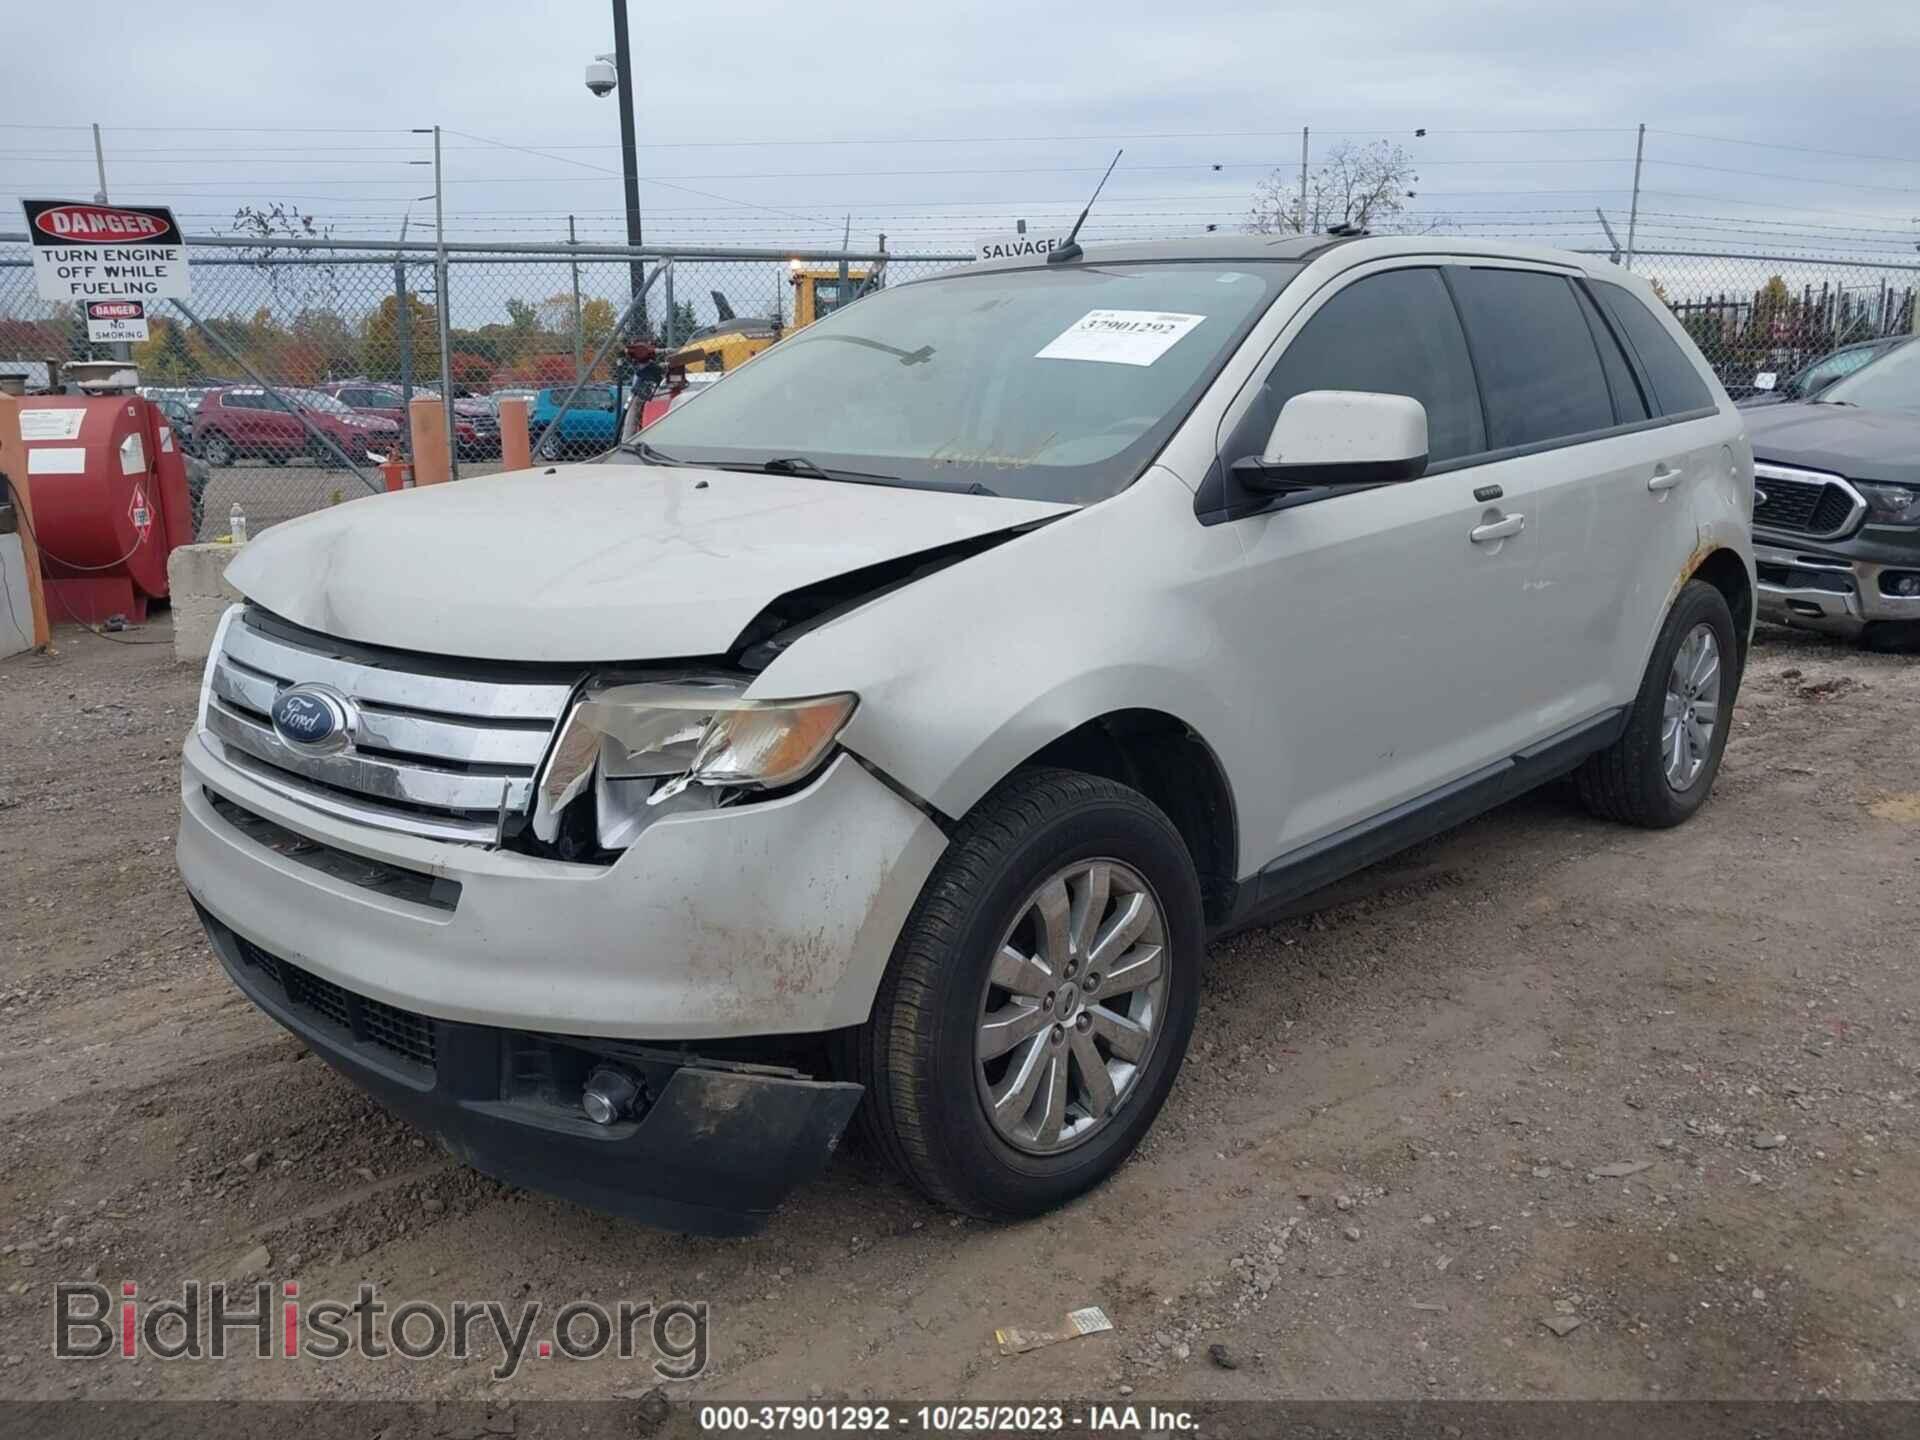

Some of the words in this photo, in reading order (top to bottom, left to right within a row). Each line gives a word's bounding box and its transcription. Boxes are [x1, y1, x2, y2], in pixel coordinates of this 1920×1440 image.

[51, 212, 158, 233] DANGER
[42, 249, 98, 262] TURN
[104, 249, 178, 261] ENGINE
[57, 266, 96, 279] OFF
[103, 265, 168, 277] WHILE
[70, 282, 158, 295] FUELING
[95, 305, 137, 316] DANGER
[109, 321, 125, 330] NO
[95, 331, 143, 340] SMOKING
[280, 696, 321, 733] Ford
